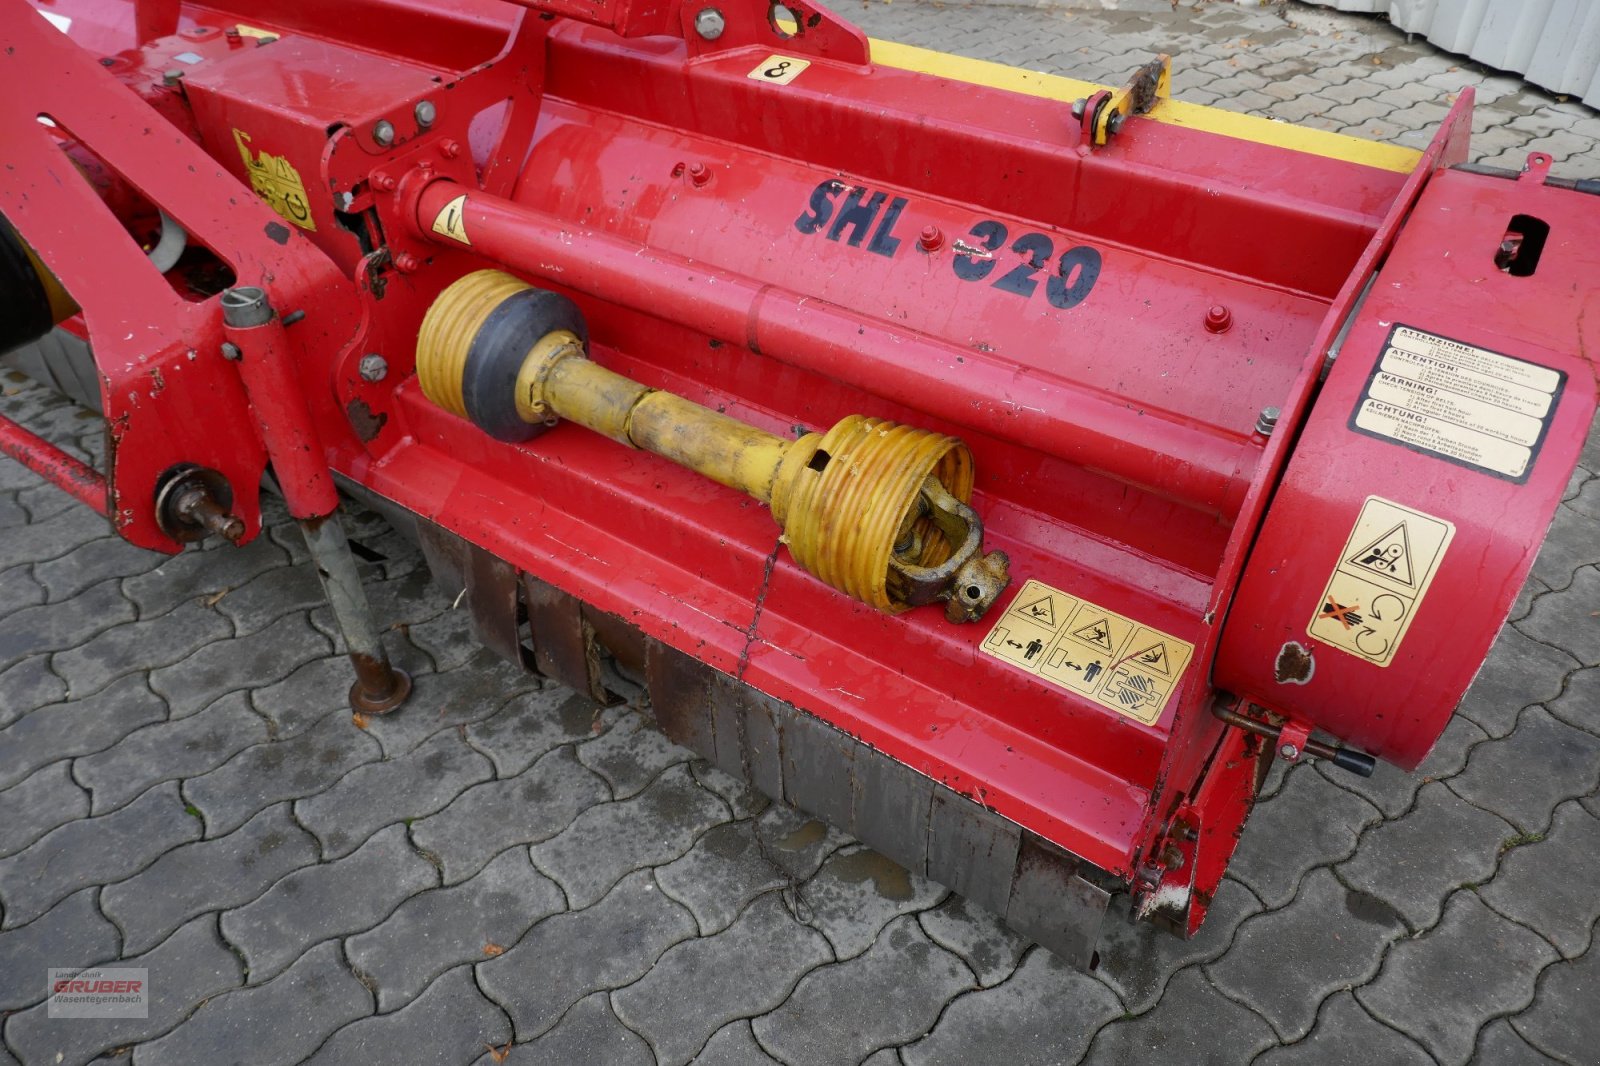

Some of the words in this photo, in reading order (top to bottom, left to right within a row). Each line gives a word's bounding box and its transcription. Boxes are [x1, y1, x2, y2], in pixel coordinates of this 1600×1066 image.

[794, 178, 911, 258] SHL
[952, 220, 1103, 310] 320
[1400, 328, 1474, 353] ATTENZIONE!
[1391, 349, 1458, 372] ATTENTION!
[1433, 367, 1459, 378] TENSION
[1378, 379, 1398, 388] CHECK
[1398, 386, 1425, 396] TENSION
[1380, 373, 1438, 395] WARNING!
[1367, 400, 1427, 424] ACHTUNG!
[1447, 410, 1465, 418] hours
[1401, 429, 1416, 437] Nach
[1416, 434, 1431, 442] rund
[1419, 407, 1441, 416] regular
[1484, 427, 1509, 438] working
[1509, 434, 1528, 443] hours
[1436, 435, 1457, 444] halben
[1457, 441, 1479, 451] Stunde
